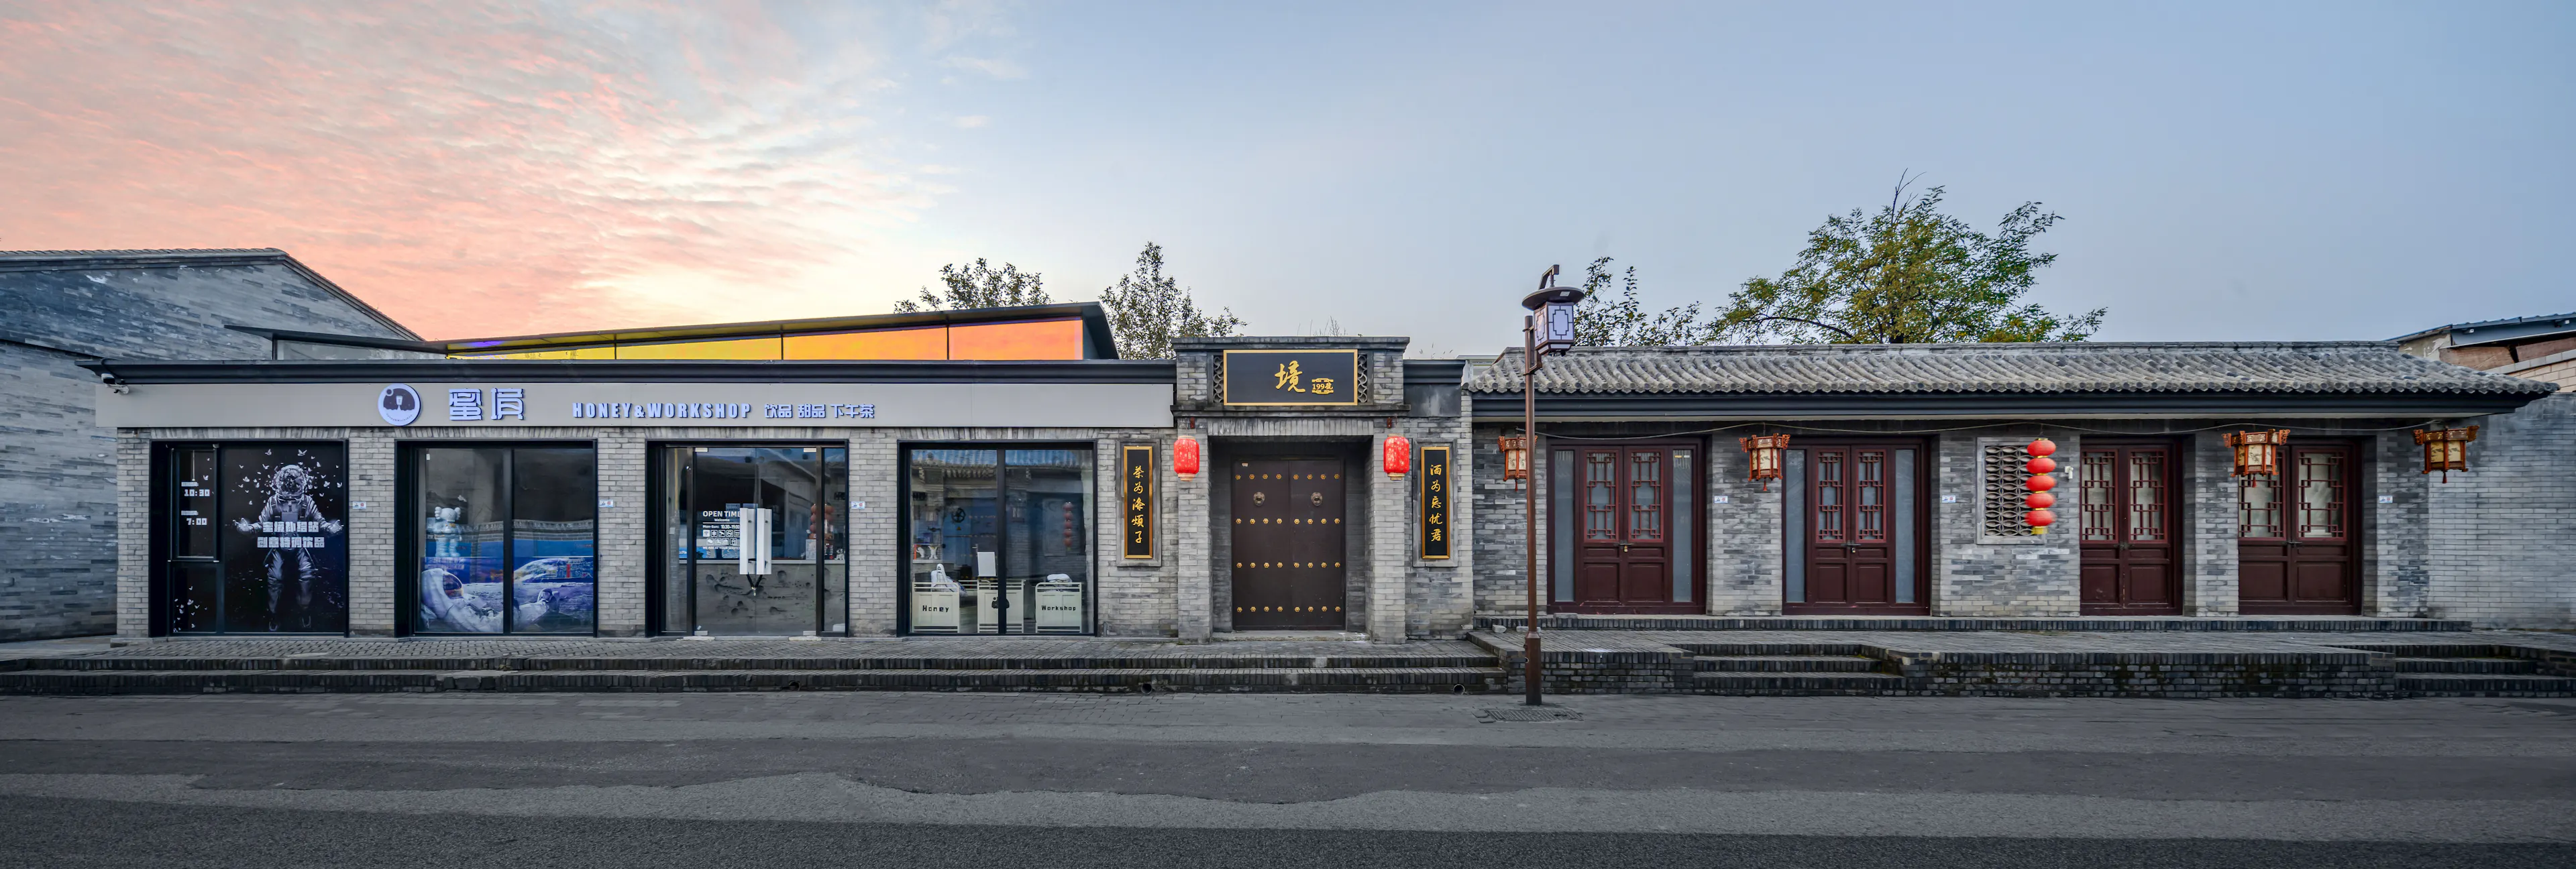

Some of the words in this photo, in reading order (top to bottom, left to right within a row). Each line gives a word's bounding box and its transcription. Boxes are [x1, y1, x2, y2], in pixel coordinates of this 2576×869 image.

[1275, 360, 1306, 392] 境
[572, 402, 751, 418] HONEY&WORKSHOP
[764, 404, 793, 418] 饮品
[798, 404, 826, 418] 甜品
[830, 404, 875, 418] 下午茶
[184, 489, 210, 497] 10:30
[186, 518, 207, 526] 7:00
[257, 536, 325, 548] 创意特调饮品
